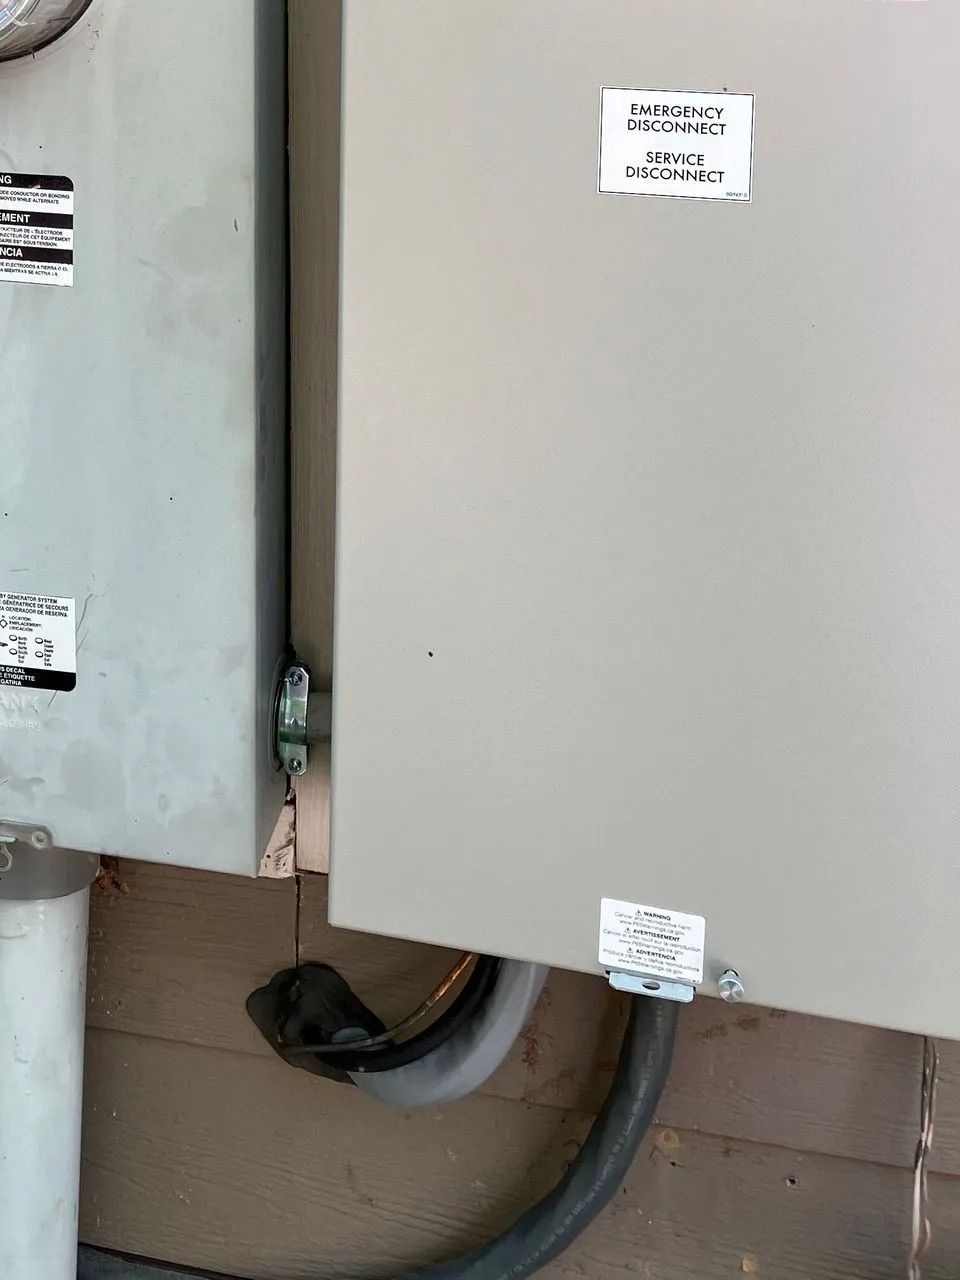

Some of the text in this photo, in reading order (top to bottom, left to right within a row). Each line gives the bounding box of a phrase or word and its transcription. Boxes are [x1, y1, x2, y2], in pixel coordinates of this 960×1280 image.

[631, 104, 724, 120] EMERGENCY
[627, 119, 727, 136] DISCONNECT
[646, 151, 705, 166] SERVICE
[626, 166, 726, 183] DISCONNECT
[2, 598, 36, 608] GÉNÉRATRICE
[6, 606, 36, 614] GENERADOR
[643, 912, 670, 920] WARNING
[646, 919, 676, 928] reproductive
[632, 929, 680, 942] AVERTISSEMENT
[636, 949, 676, 961] ADVERTENCIA
